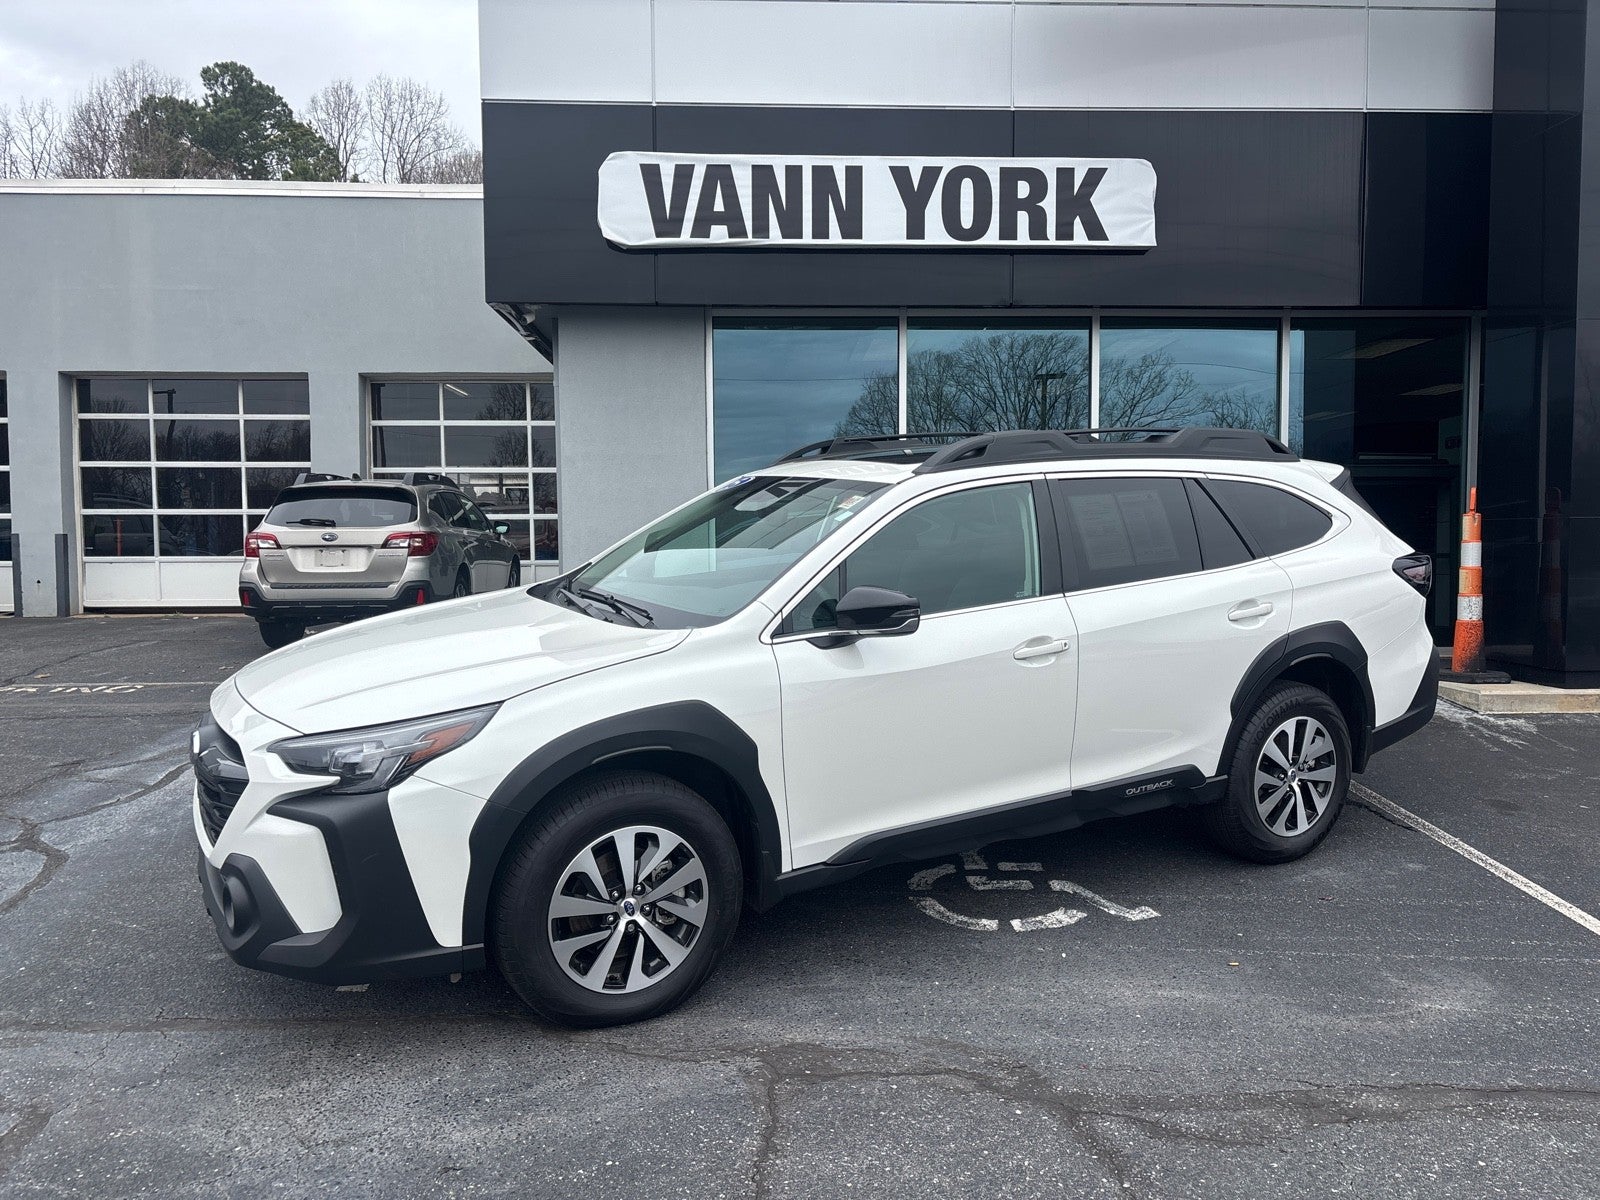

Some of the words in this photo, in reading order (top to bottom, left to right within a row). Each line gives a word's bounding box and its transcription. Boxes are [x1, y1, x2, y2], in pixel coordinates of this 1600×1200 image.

[639, 162, 864, 241] VANN
[888, 164, 1110, 242] YORK
[1250, 697, 1302, 746] YOKOHAMA
[1125, 778, 1174, 796] OUTBACK
